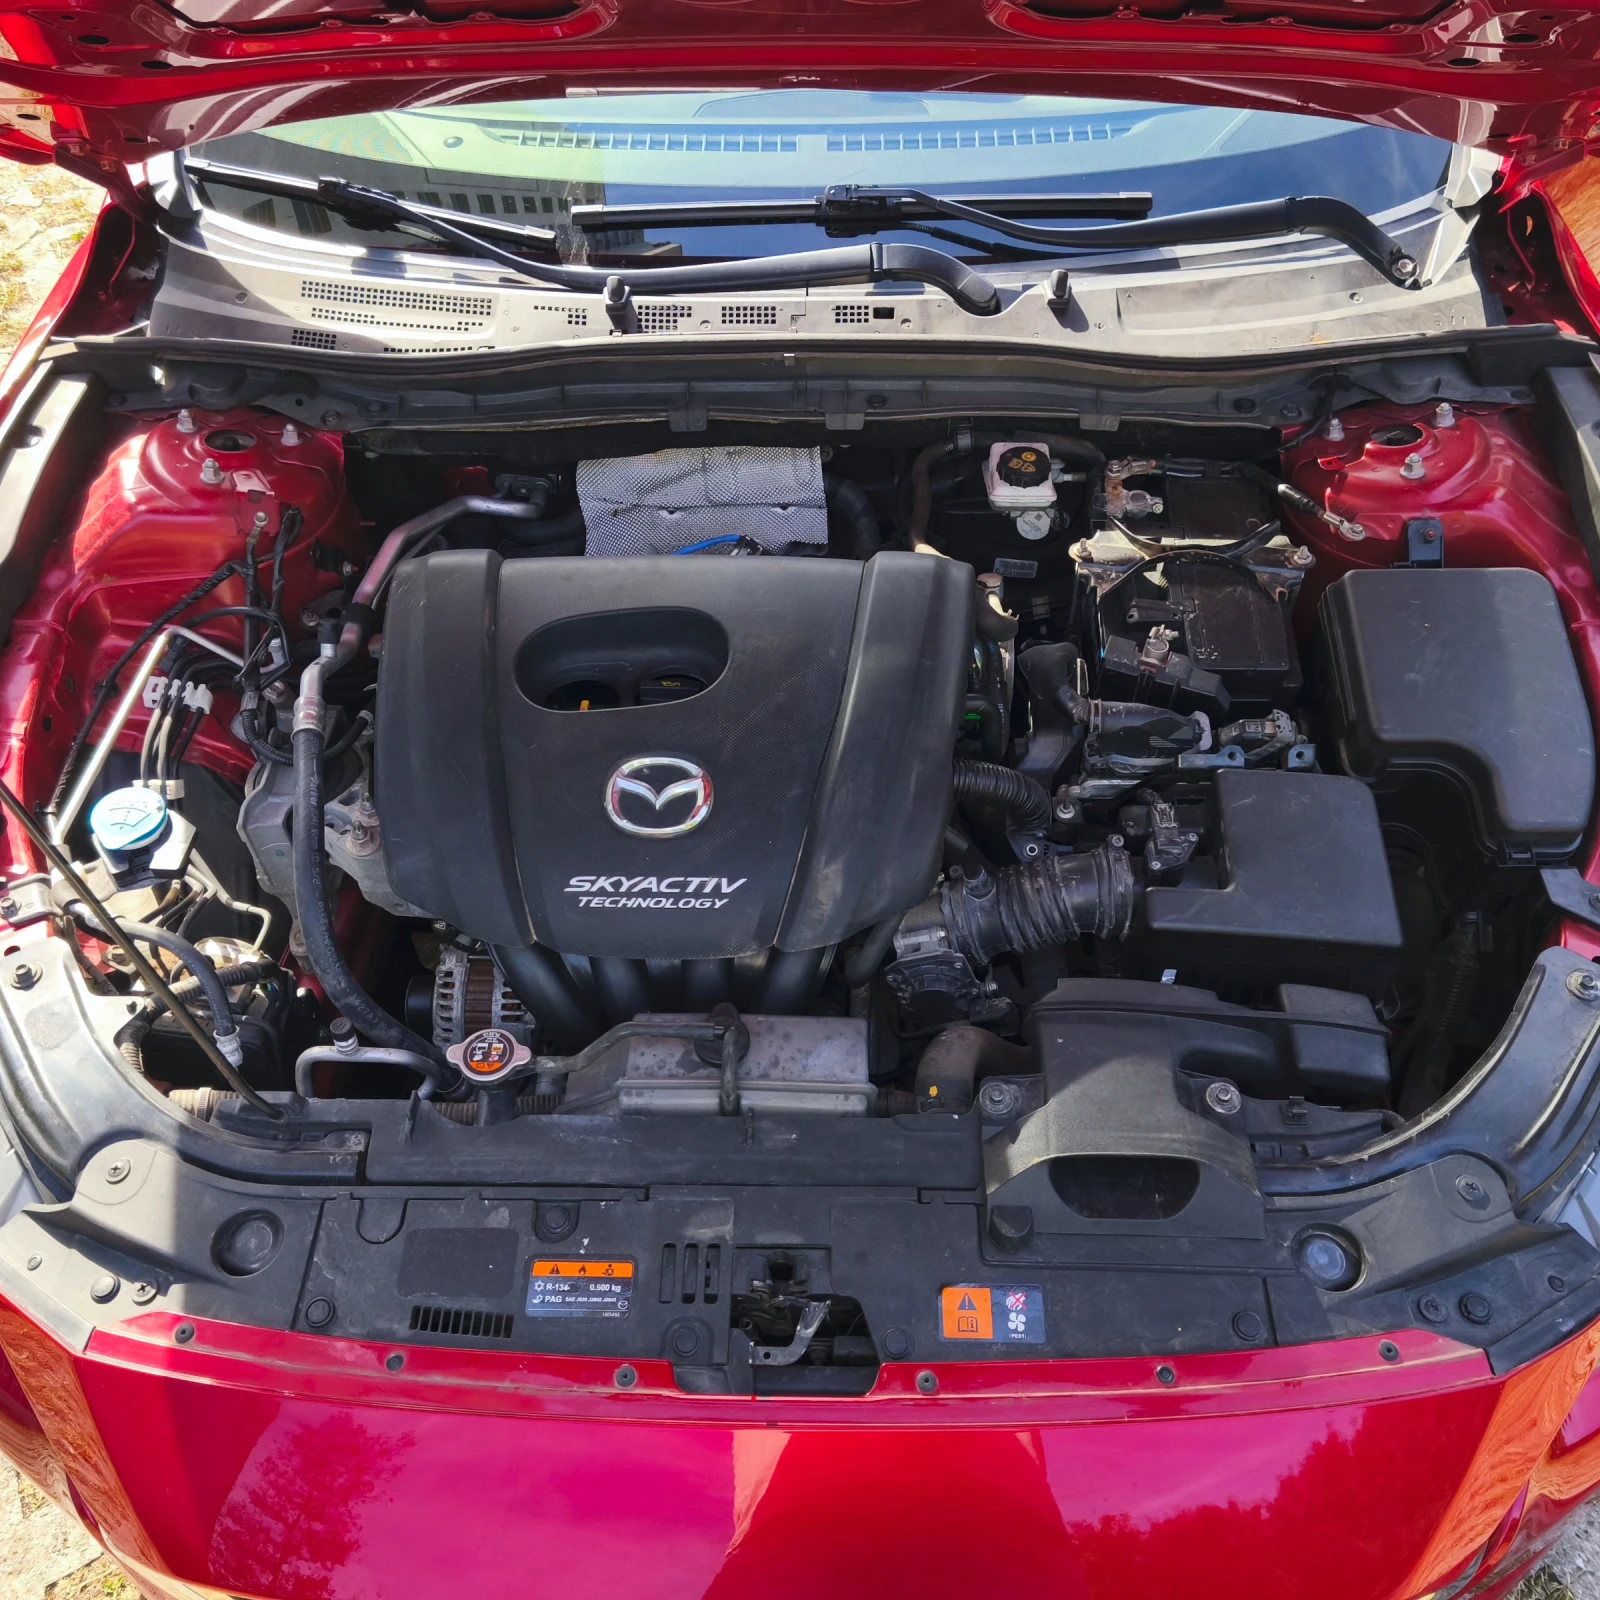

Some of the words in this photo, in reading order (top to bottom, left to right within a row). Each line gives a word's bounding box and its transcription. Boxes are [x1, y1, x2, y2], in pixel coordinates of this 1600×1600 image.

[310, 776, 320, 806] Parker
[564, 876, 747, 893] SKYACTIV
[578, 896, 729, 909] TECHNOLOGY
[546, 1282, 570, 1292] R-134
[589, 1284, 609, 1292] 0.500
[611, 1284, 621, 1293] kg
[544, 1295, 562, 1303] PAG
